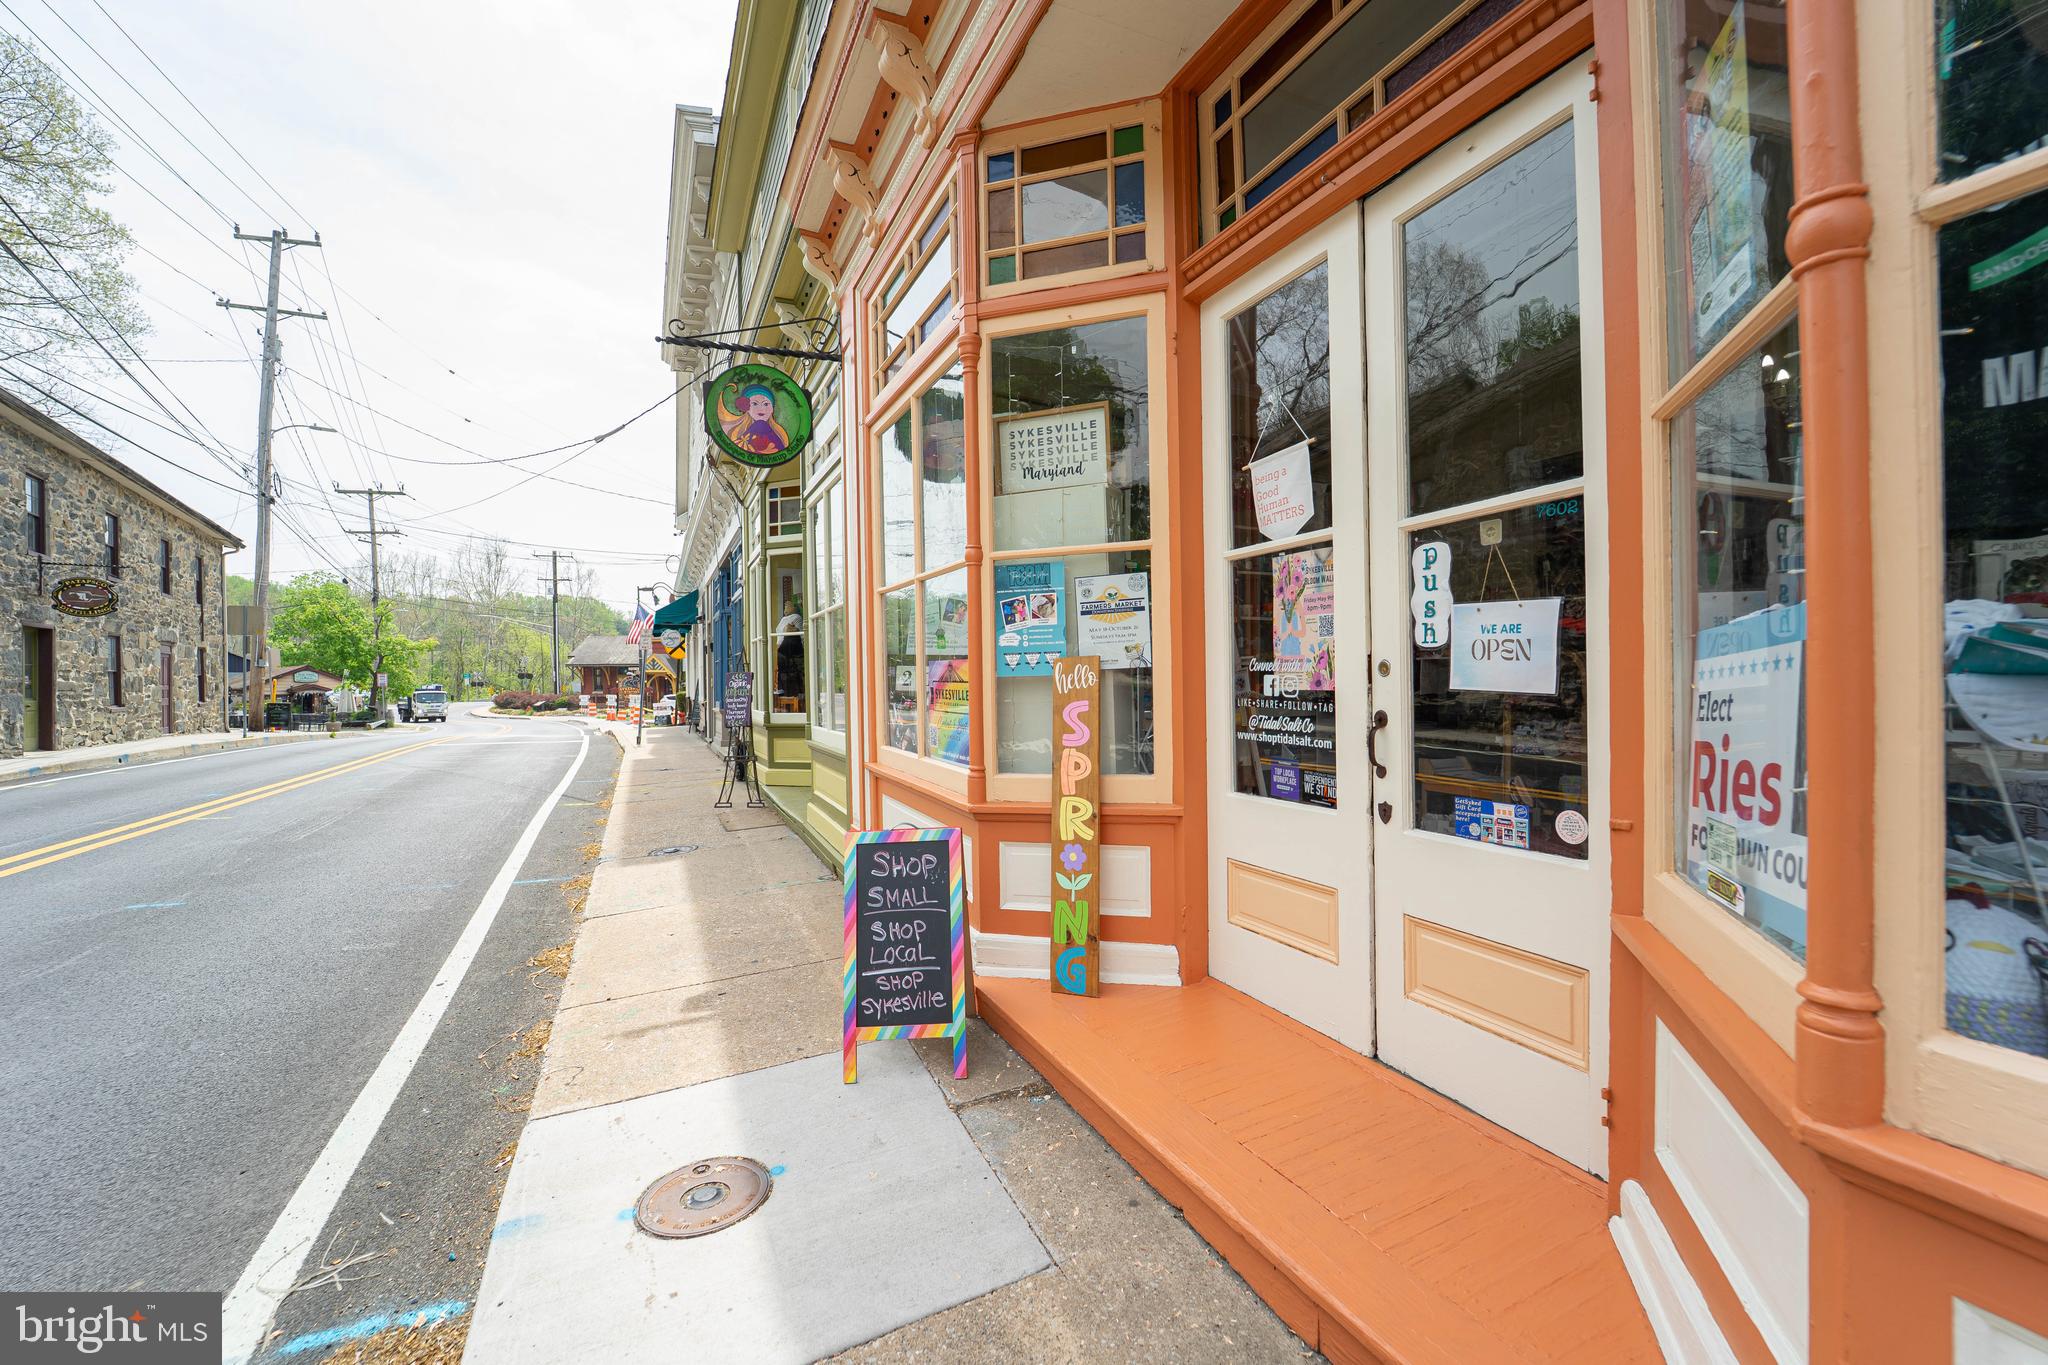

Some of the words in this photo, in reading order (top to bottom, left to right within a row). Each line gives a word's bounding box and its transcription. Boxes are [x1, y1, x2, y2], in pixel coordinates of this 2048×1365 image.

[1982, 346, 2048, 407] M
[1009, 420, 1097, 440] SYKESVILLE
[1009, 431, 1098, 451] SYKESVILLE
[1010, 442, 1098, 461] SYKESVILLE
[1010, 453, 1098, 472] SYKESVILLE
[1022, 461, 1085, 481] Maryland
[1255, 470, 1280, 486] being
[1281, 468, 1287, 476] a
[1256, 485, 1279, 501] Good
[1258, 496, 1289, 514] Human
[1537, 500, 1578, 519] 7602
[1260, 504, 1305, 527] MATTERS
[64, 579, 107, 587] PATAPSCO
[1422, 546, 1438, 644] push
[60, 605, 112, 614] DISTILLING
[1081, 602, 1112, 611] FARMERS
[1115, 599, 1142, 608] MARKET
[1481, 625, 1497, 634] WE
[1500, 624, 1522, 633] ARE
[1471, 639, 1532, 661] OPEN
[1249, 657, 1281, 672] Connect
[1055, 662, 1098, 694] hello
[935, 688, 968, 701] SYKESVILLE
[1697, 690, 1733, 722] Elect
[1249, 715, 1315, 733] @TidalSaltCo
[1237, 731, 1332, 749] www.shoptidalsalt.com
[1273, 775, 1296, 785] WORKPLACE
[1283, 769, 1295, 778] LOCAL
[1691, 734, 1782, 827] Ries
[1304, 782, 1314, 794] WE
[1692, 824, 1708, 851] FO
[871, 852, 938, 879] SHOP
[867, 886, 939, 909] SMALL
[870, 920, 927, 942] SHOP
[876, 971, 924, 991] SHOP
